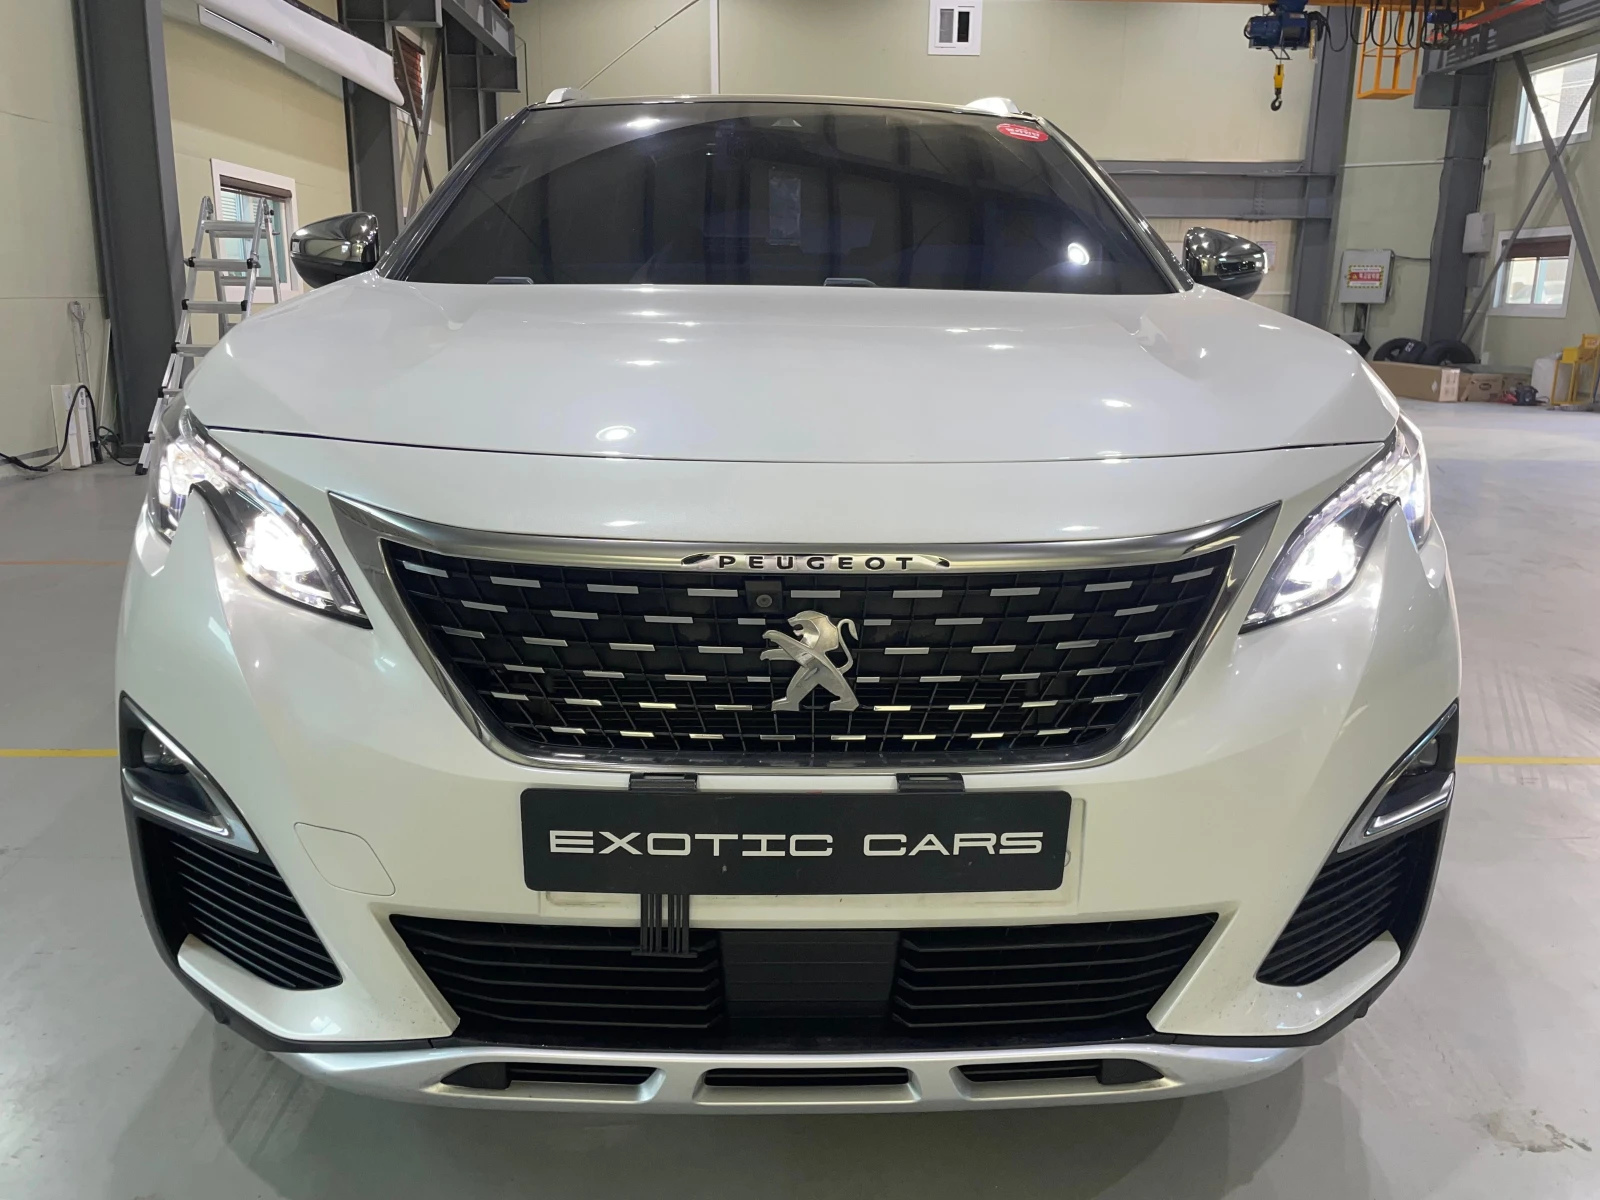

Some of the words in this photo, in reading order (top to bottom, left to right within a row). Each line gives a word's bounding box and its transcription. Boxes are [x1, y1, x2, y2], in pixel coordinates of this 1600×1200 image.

[719, 556, 913, 570] PEUGEOT
[549, 830, 833, 857] EXOTIC
[863, 832, 1043, 856] CARS
